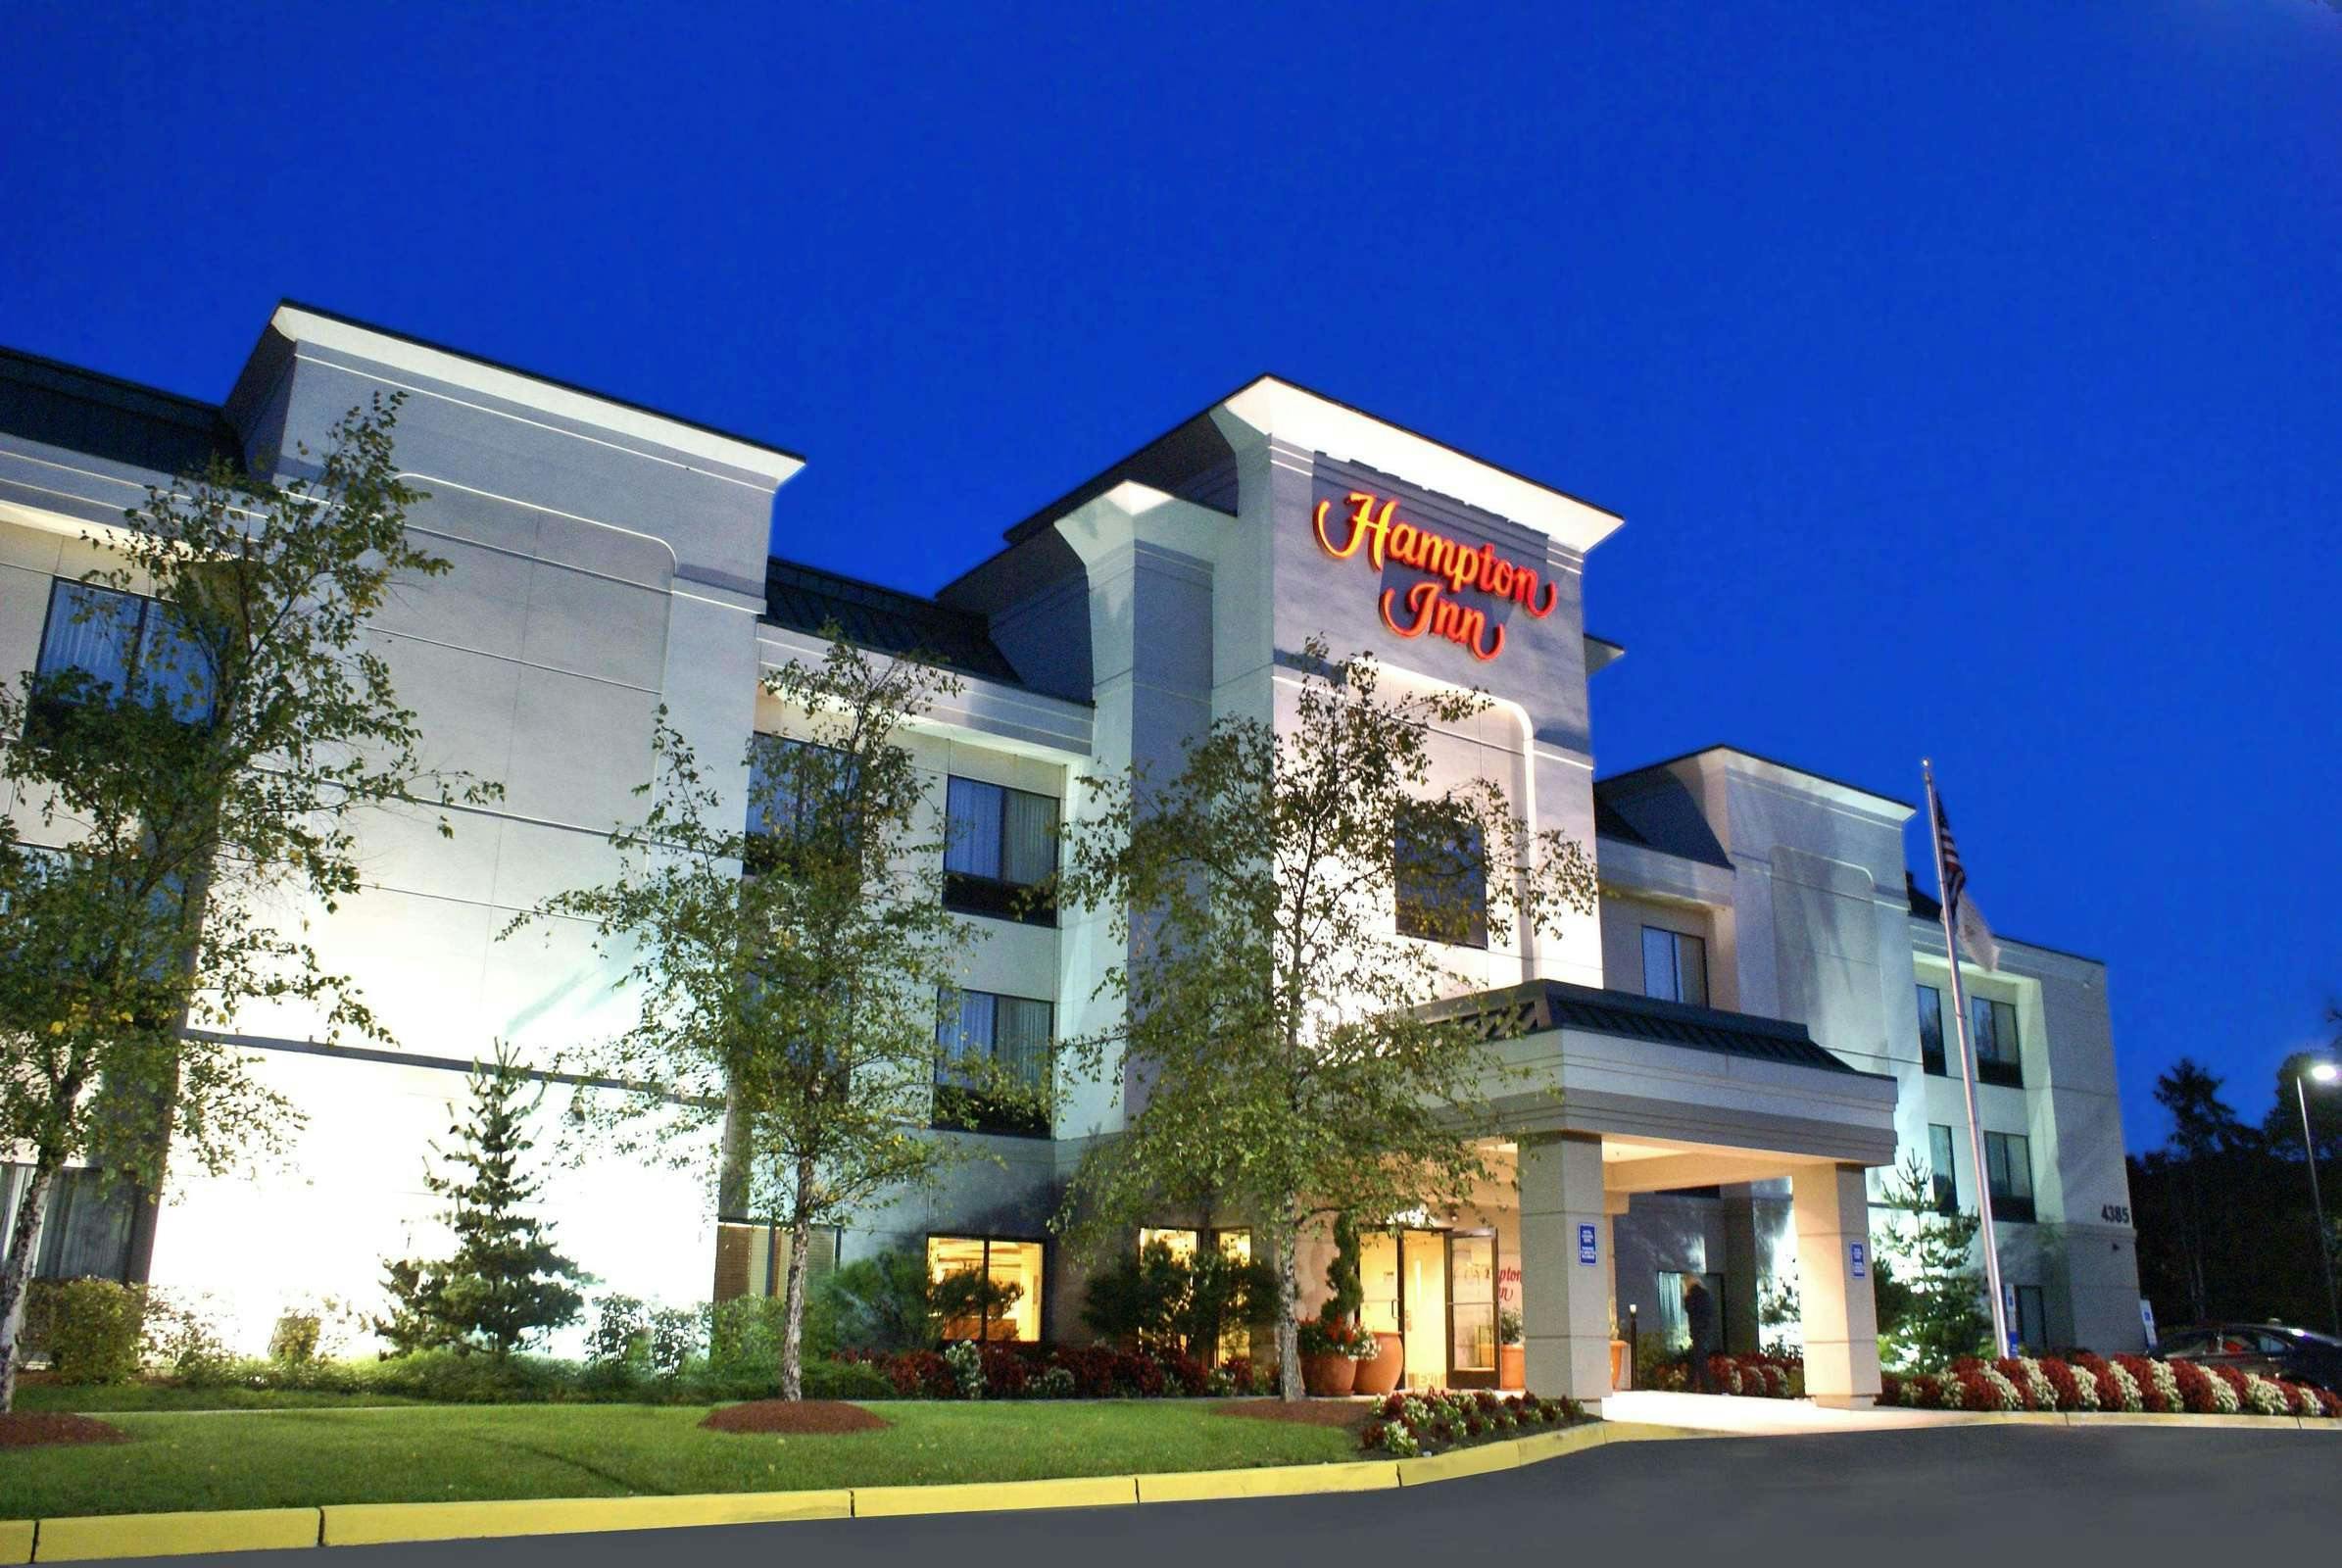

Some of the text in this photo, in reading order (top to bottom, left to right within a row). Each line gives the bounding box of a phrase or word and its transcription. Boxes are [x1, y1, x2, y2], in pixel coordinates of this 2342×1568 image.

[1312, 491, 1558, 619] Hampton
[1379, 581, 1506, 662] Inn
[2101, 1204, 2130, 1223] 4385
